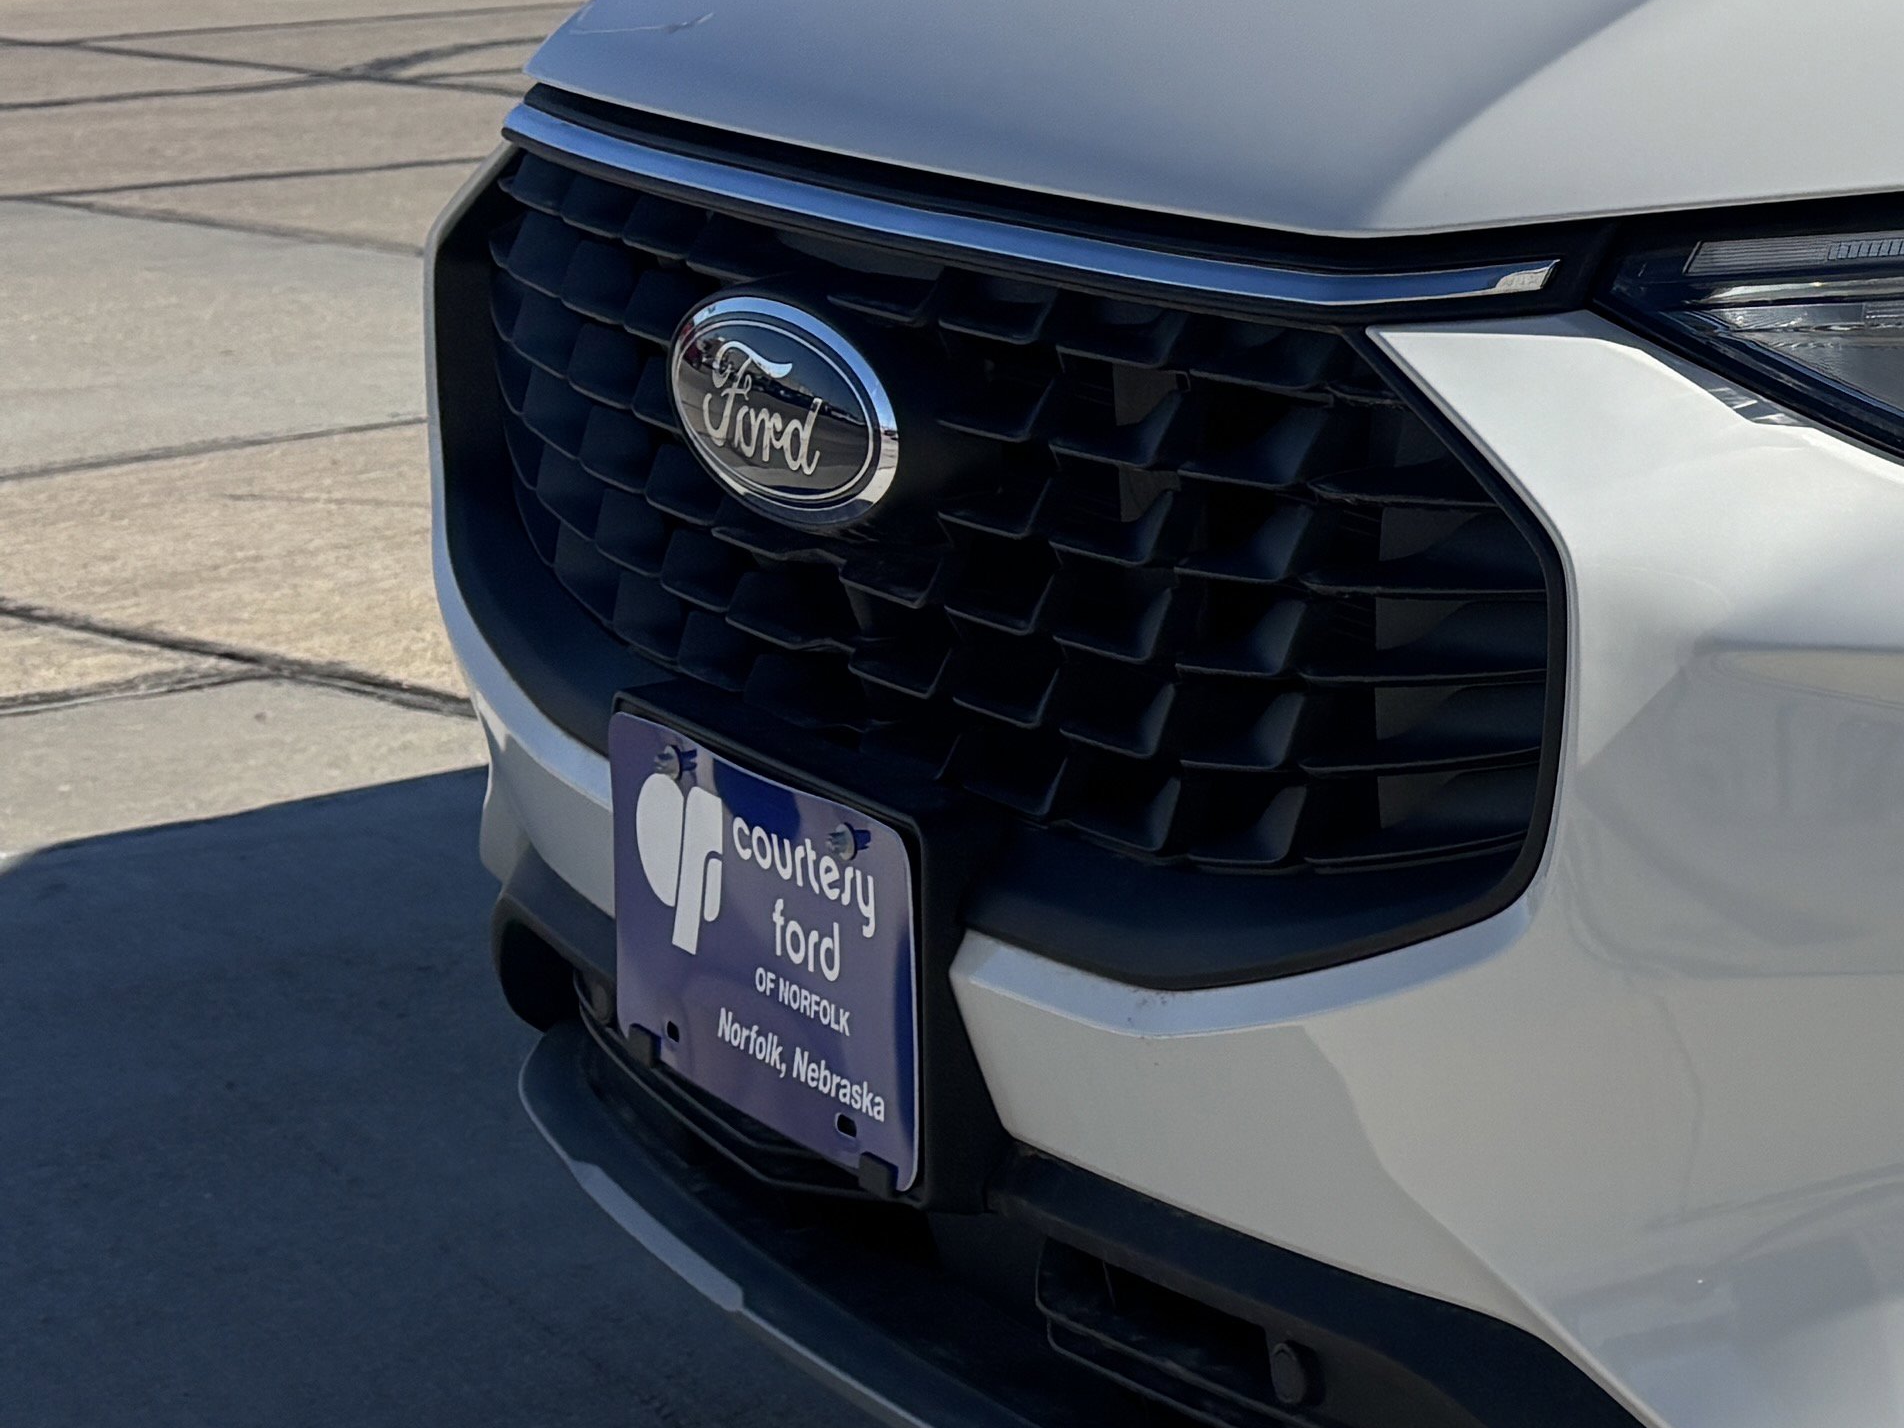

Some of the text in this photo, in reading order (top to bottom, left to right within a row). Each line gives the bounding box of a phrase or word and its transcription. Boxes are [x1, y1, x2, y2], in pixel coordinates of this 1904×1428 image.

[733, 816, 876, 938] courtesy
[772, 898, 841, 982] ford
[754, 967, 850, 1036] OF NORFOLK
[717, 1008, 885, 1122] Norfolk, Nebraska
